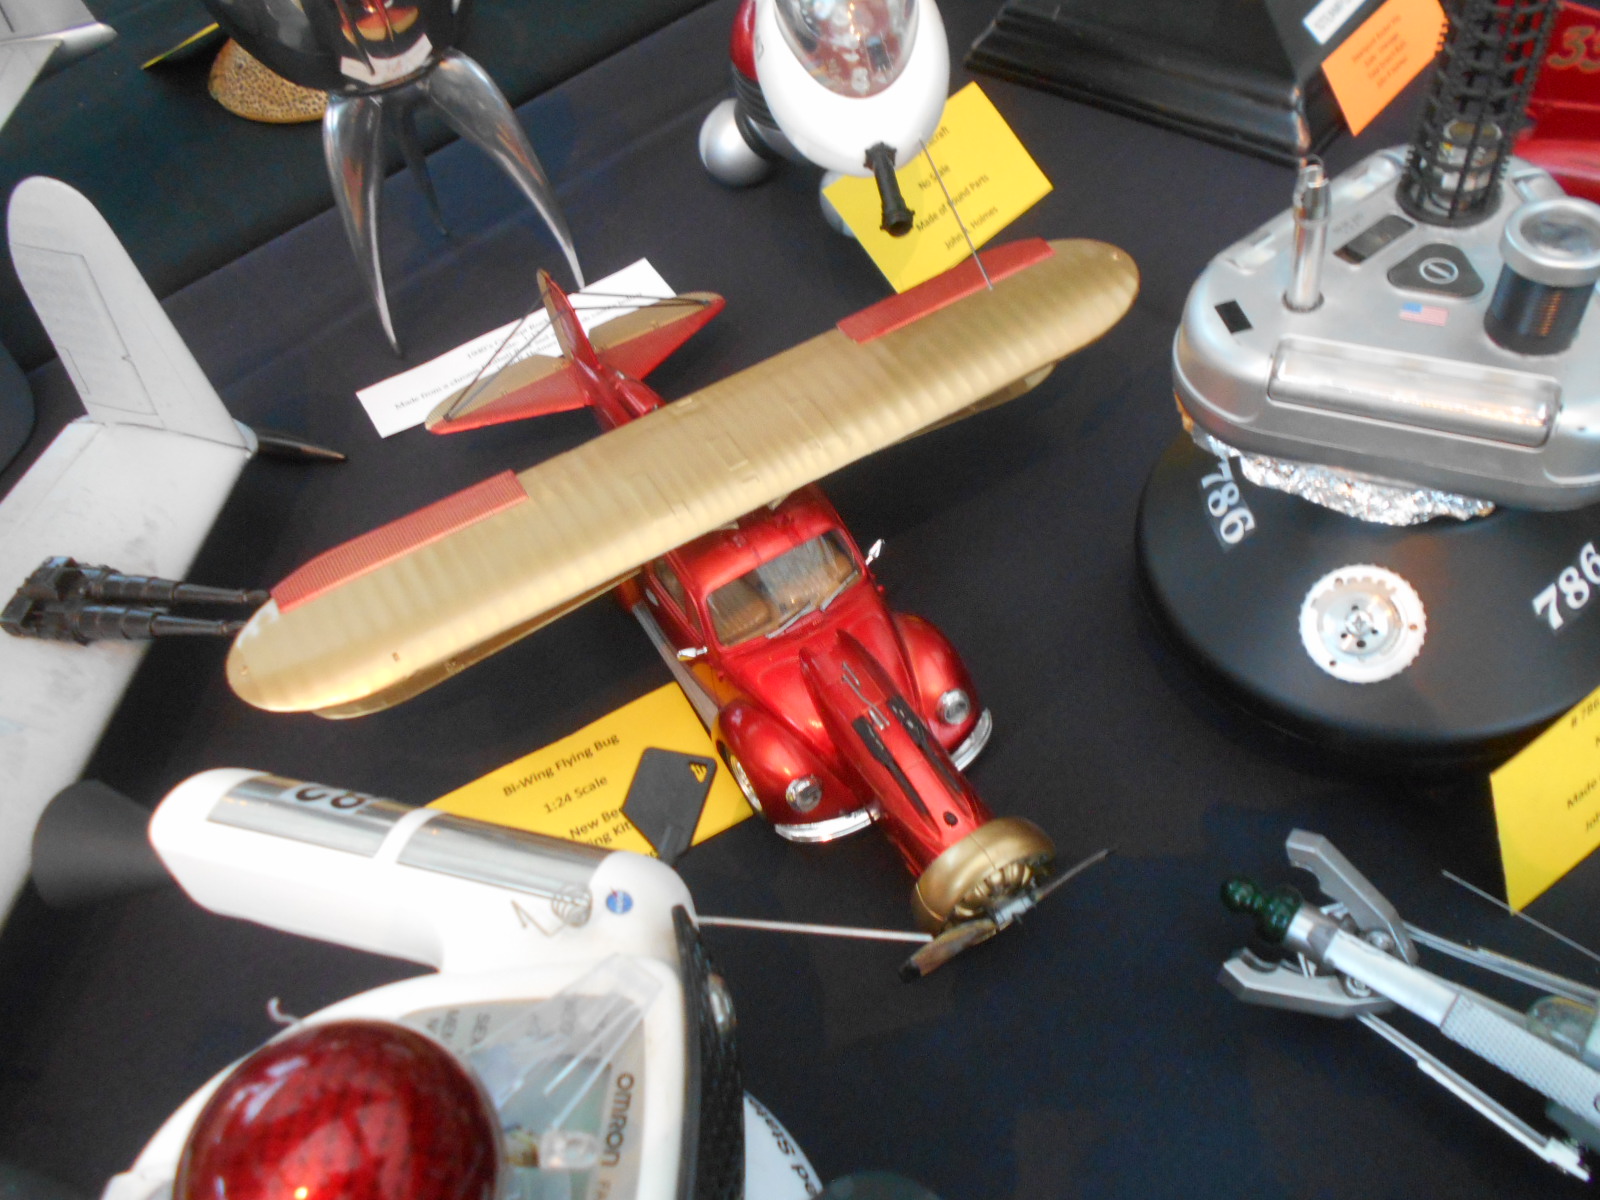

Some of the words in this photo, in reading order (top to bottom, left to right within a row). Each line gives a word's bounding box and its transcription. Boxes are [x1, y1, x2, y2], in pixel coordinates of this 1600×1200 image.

[930, 164, 951, 181] Sale
[915, 211, 938, 232] Made
[969, 173, 990, 192] Parts
[1201, 455, 1255, 544] 786
[1531, 541, 1600, 630] 786
[555, 748, 593, 770] Flying
[594, 734, 619, 751] Bug
[544, 793, 572, 814] 1:24
[574, 776, 607, 798] Scale
[569, 818, 598, 839] New
